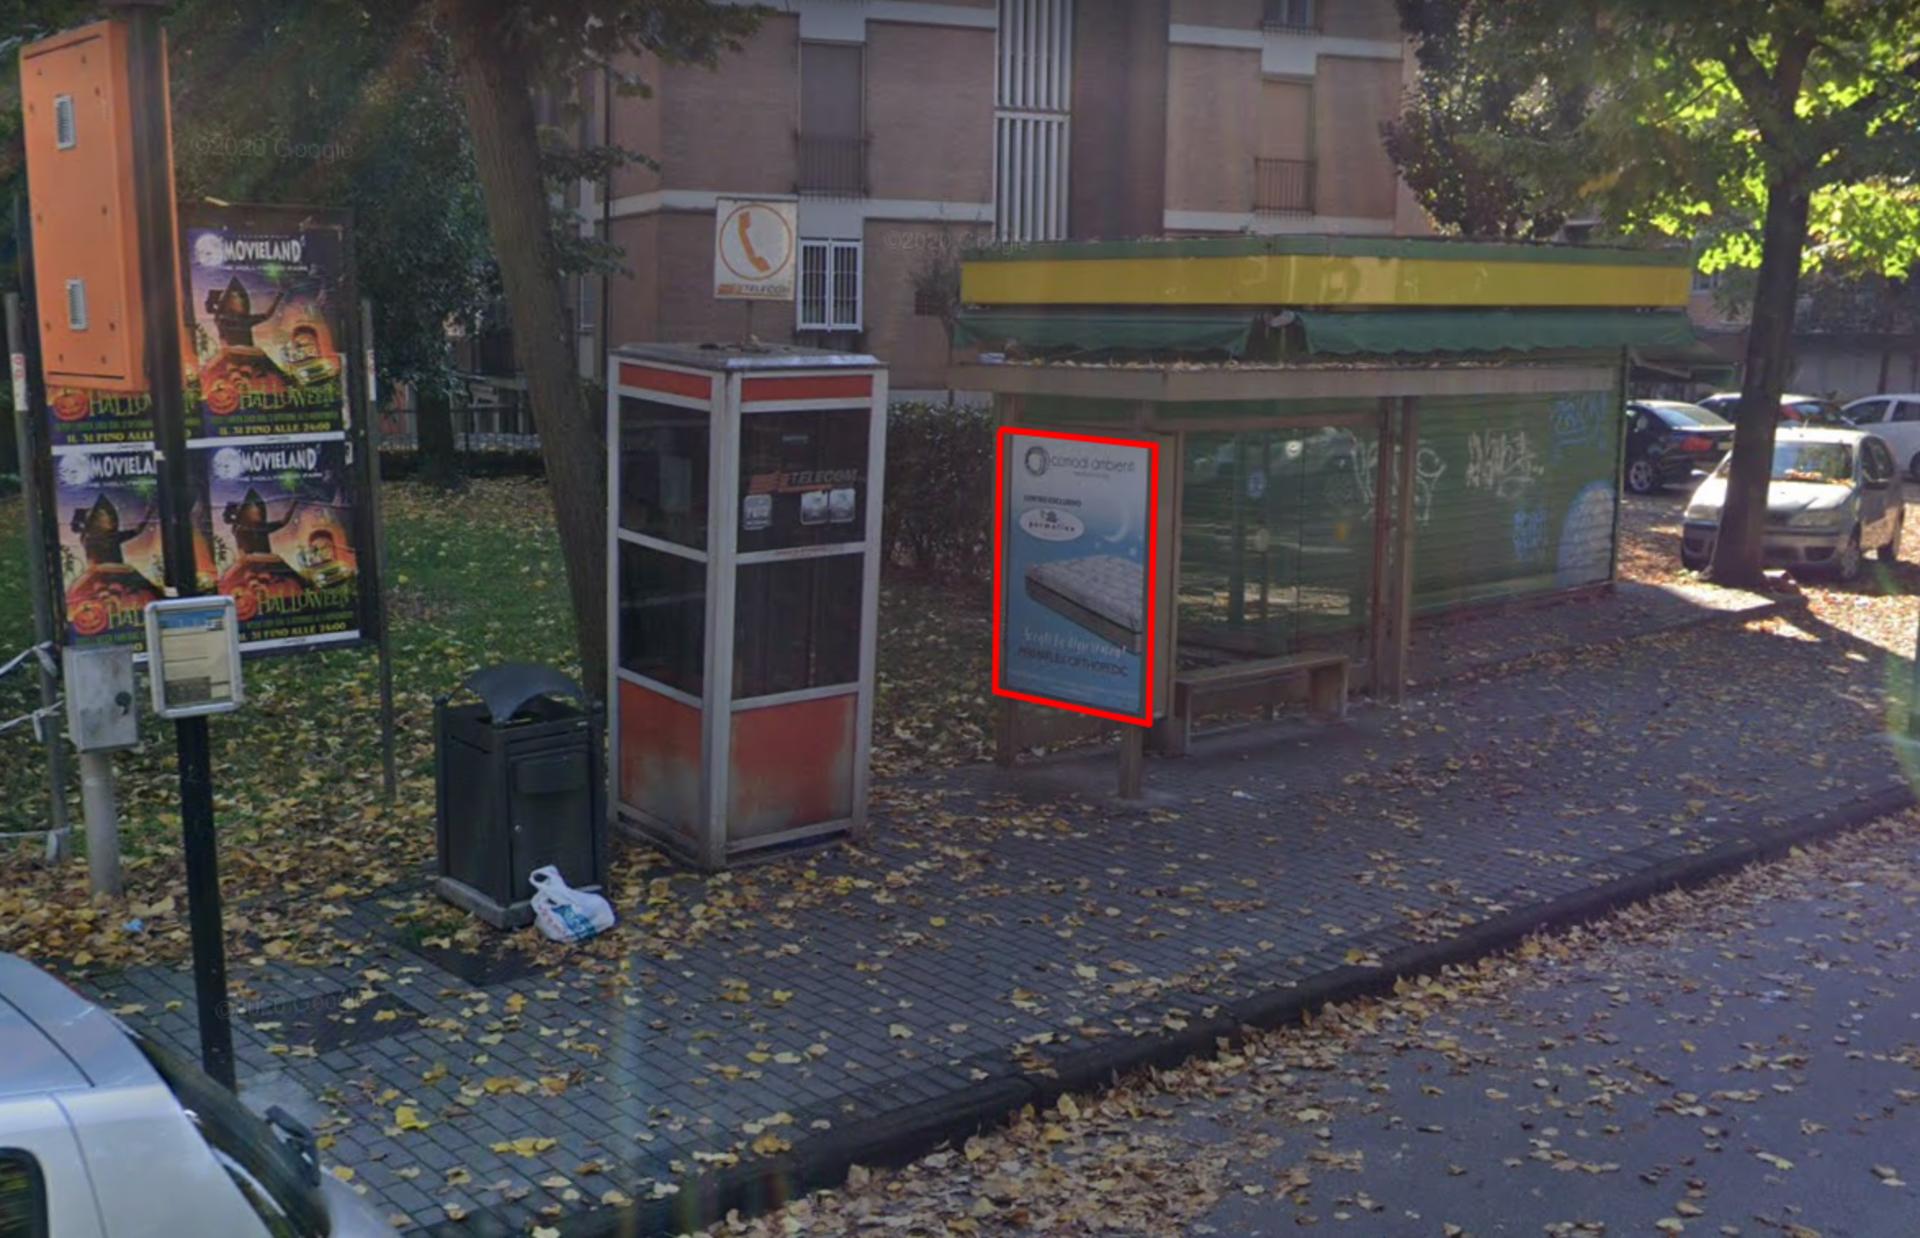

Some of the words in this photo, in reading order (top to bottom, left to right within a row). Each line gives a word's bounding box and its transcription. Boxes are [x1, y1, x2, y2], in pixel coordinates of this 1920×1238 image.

[223, 238, 302, 263] MOVIELAND
[88, 456, 157, 478] MOVIELA
[239, 447, 317, 472] MOVIELAND
[790, 467, 858, 486] TELECOM
[257, 583, 350, 615] HALLOWEEN
